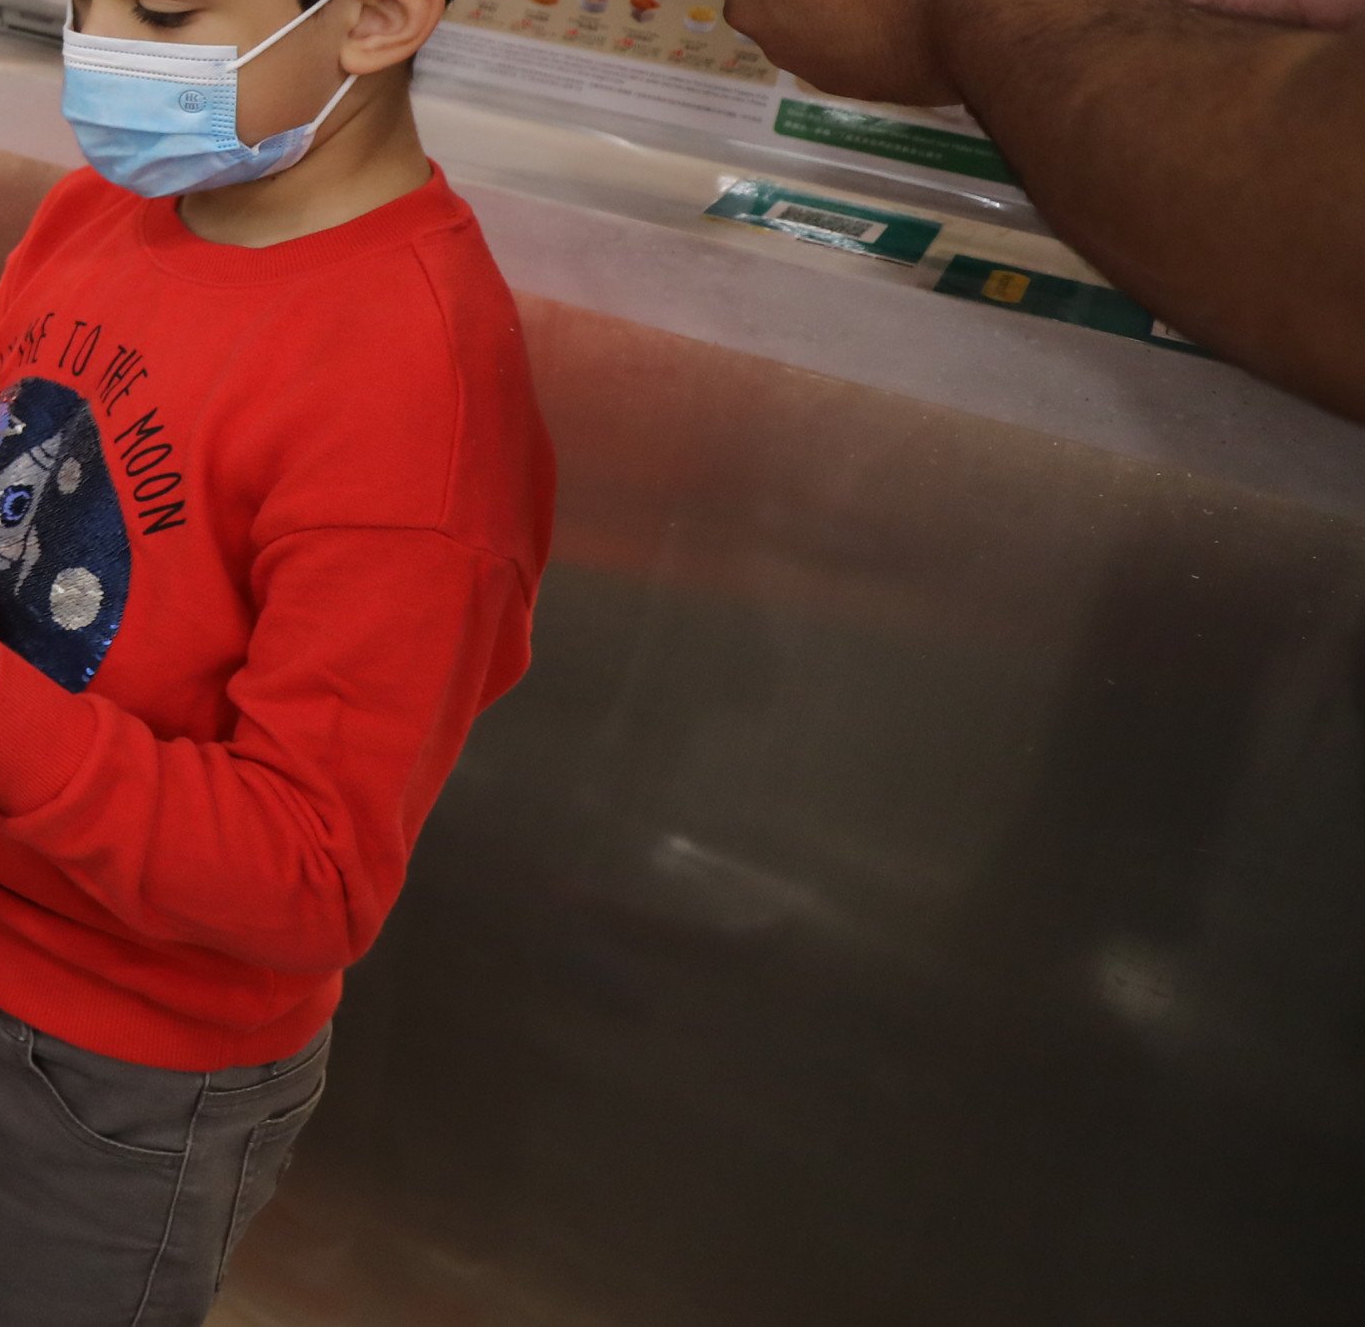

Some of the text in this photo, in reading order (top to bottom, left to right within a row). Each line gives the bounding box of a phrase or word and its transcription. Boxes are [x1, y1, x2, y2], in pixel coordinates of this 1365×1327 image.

[58, 320, 102, 377] TO
[96, 344, 148, 417] THE
[113, 406, 187, 536] MOON
